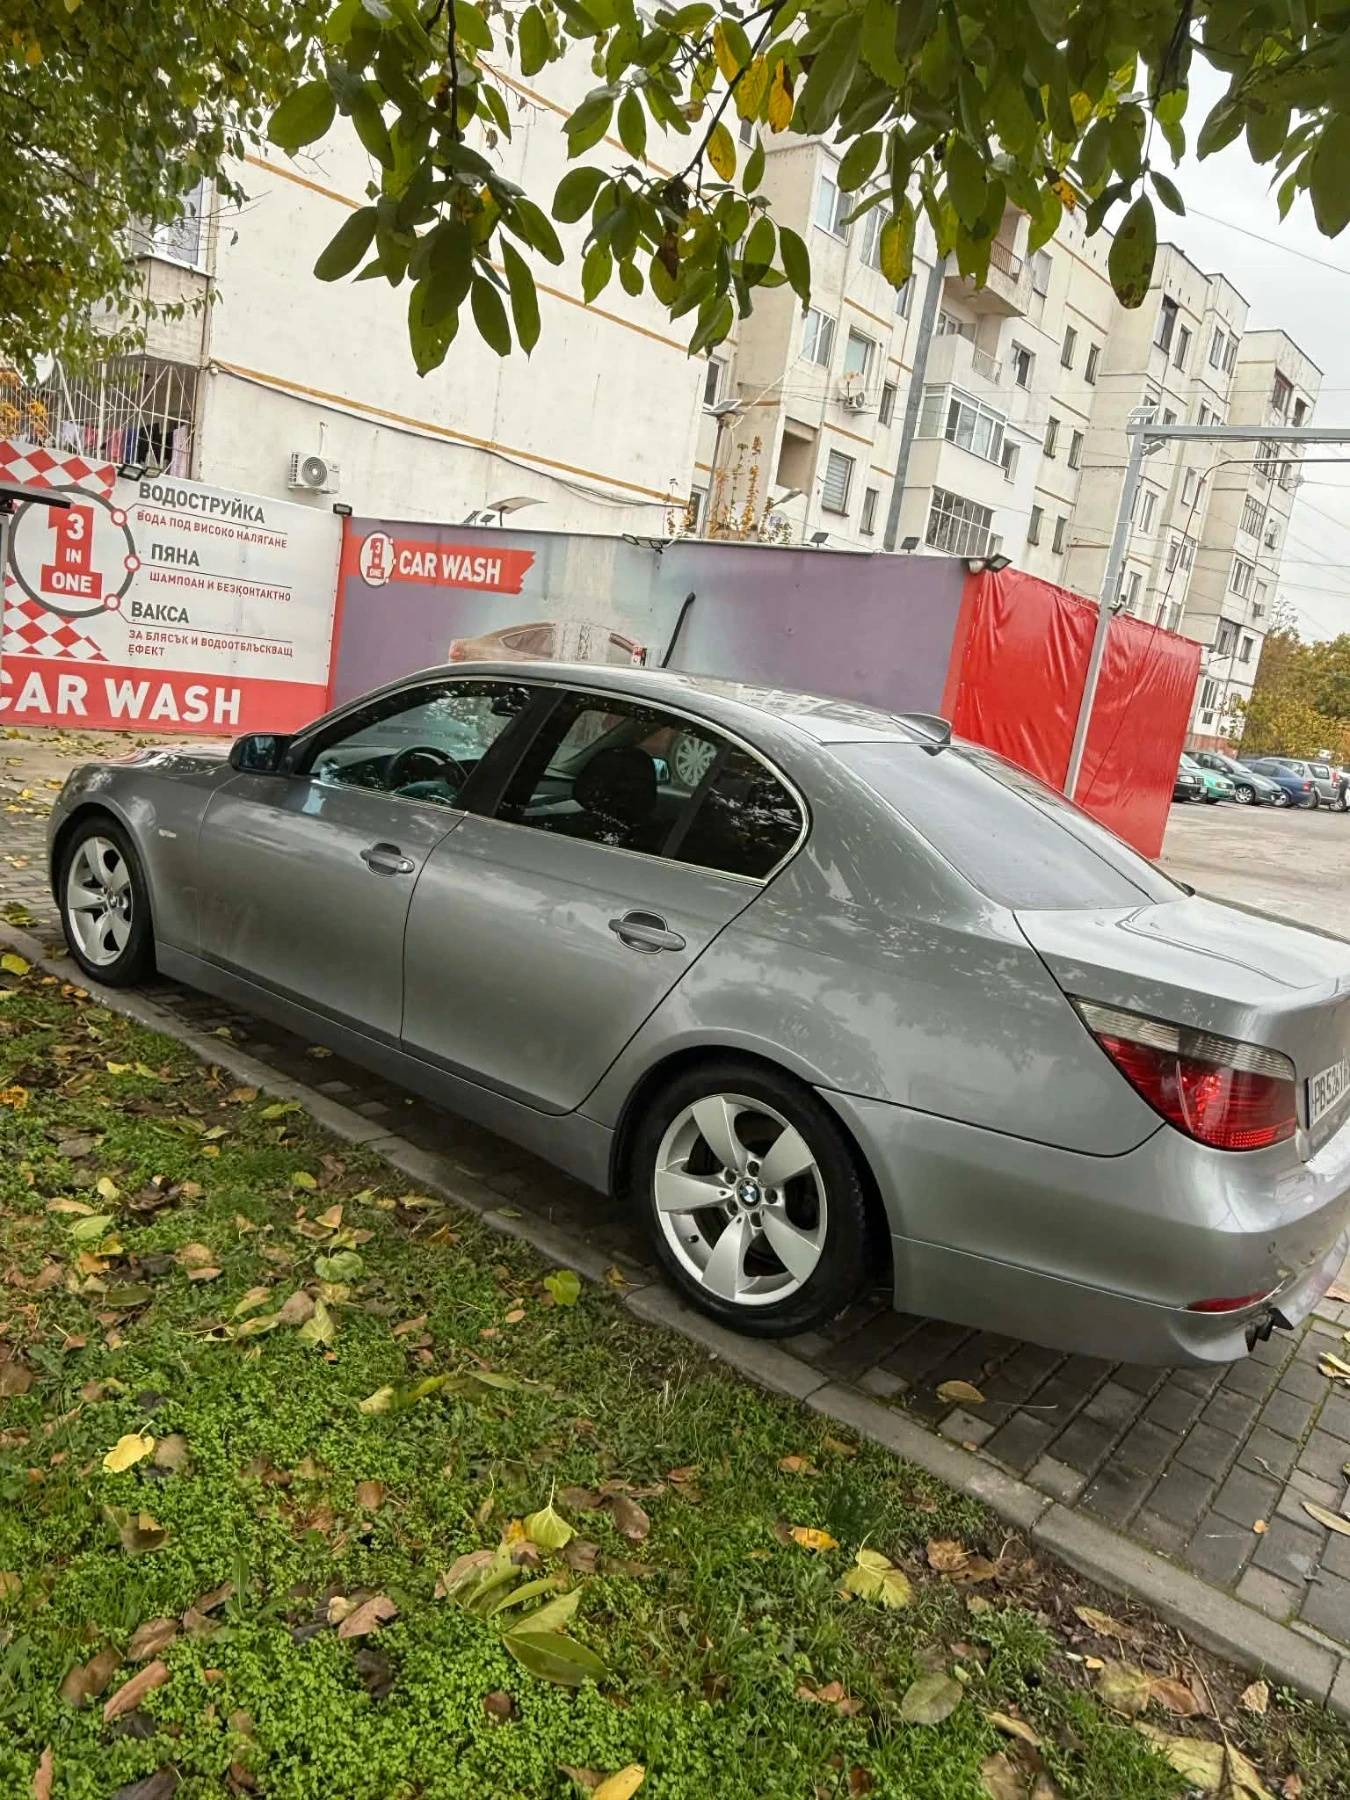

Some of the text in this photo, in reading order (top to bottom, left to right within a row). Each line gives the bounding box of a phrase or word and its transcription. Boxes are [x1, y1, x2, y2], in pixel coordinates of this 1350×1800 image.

[139, 482, 265, 523] ВОДОСТРУЙКА
[66, 513, 84, 540] 3
[137, 511, 288, 549] ВОДА ПОД ВИСОКО НАЛЯГАНЕ
[65, 548, 82, 563] IN
[151, 543, 200, 567] ПЯНА
[399, 550, 501, 584] CAR WASH
[51, 571, 92, 593] ONE
[150, 571, 291, 602] ШАМПОАН И БЕЗКОНТАКТНО
[131, 601, 190, 624] ВАКСА
[128, 630, 293, 658] ЗА БЛЯСЪК И ВОДООТБЛЪСКВАЩ
[128, 644, 165, 656] ЕФЕКТ
[104, 677, 241, 725] WASH
